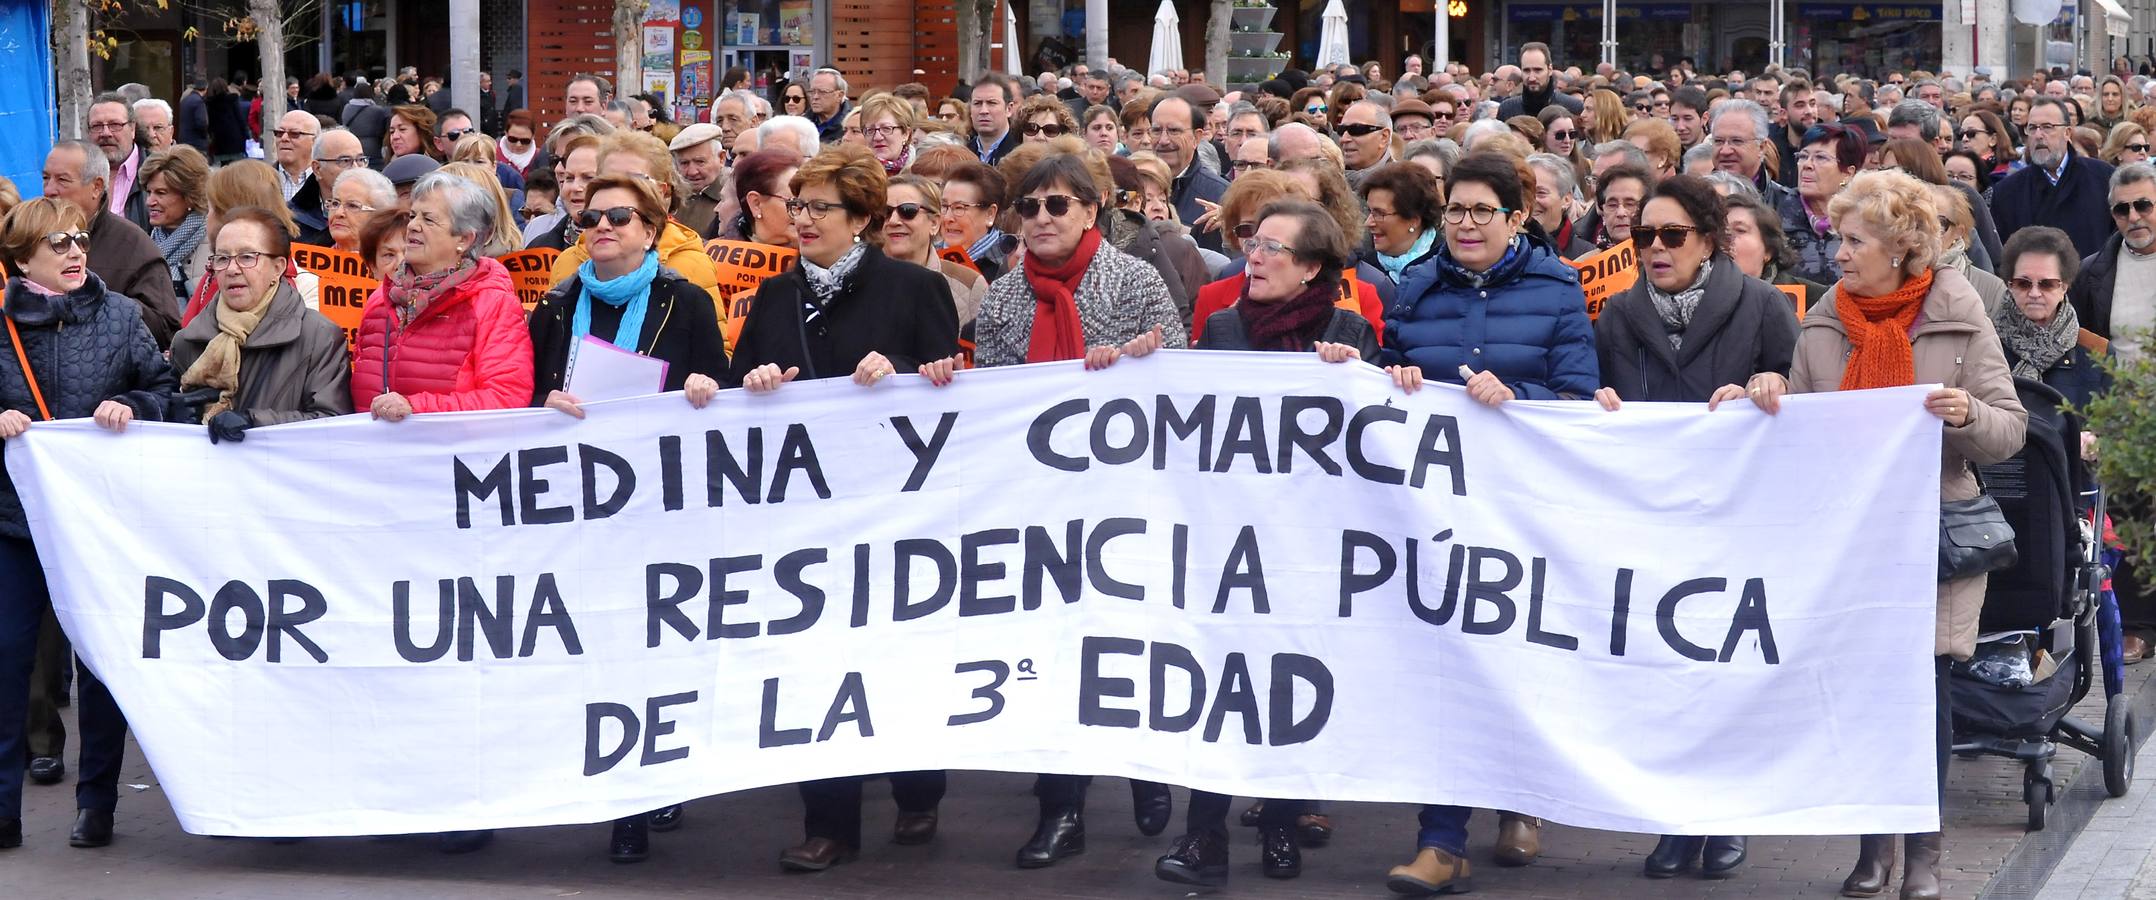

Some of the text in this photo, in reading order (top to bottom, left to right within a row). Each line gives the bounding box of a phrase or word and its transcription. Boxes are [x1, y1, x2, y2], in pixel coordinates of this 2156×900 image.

[294, 249, 375, 280] EDINA
[706, 244, 797, 273] MEDIN
[1579, 247, 1633, 286] DINA
[736, 272, 756, 284] POR
[1591, 284, 1606, 297] UNA
[453, 394, 1467, 529] MEDINA Y COMARCA
[142, 518, 1780, 665] POR UNA RESIDENCIA PÚBLICA
[582, 636, 1335, 777] DE LA 3ª EDAD
